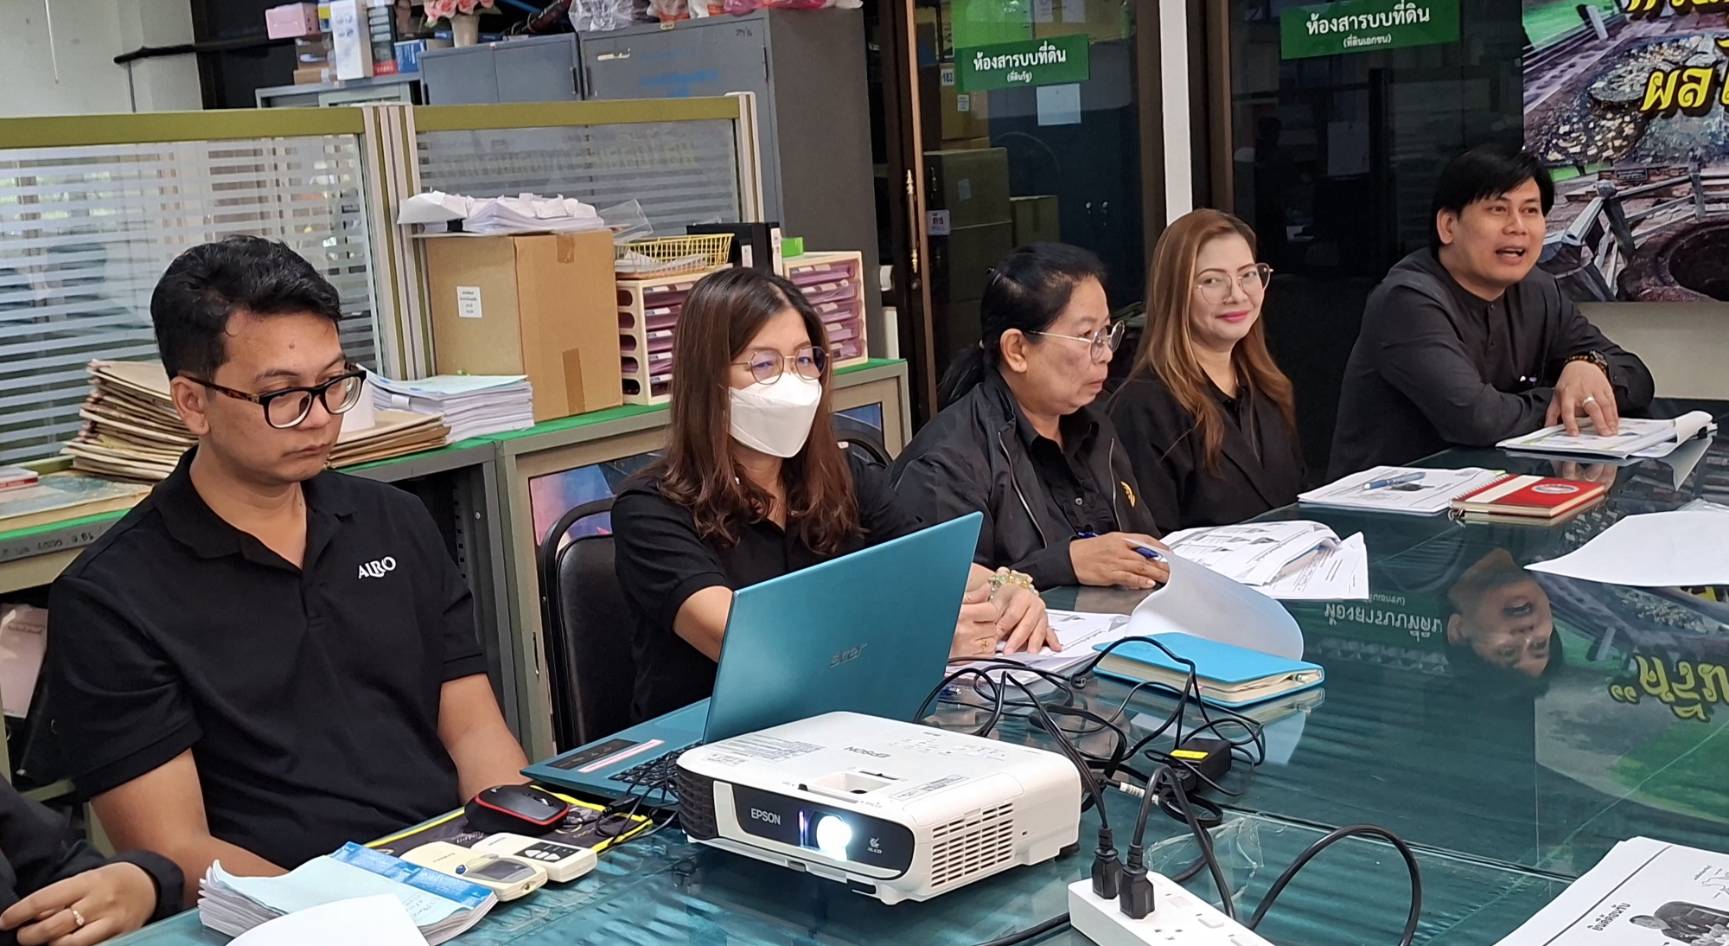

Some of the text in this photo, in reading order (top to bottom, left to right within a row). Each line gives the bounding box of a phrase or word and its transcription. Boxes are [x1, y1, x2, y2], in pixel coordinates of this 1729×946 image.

[1306, 2, 1430, 35] ห้องสารบบที่ดิน
[973, 41, 1066, 71] ห้องสารบบที่ดิน
[751, 807, 781, 825] EPSON
